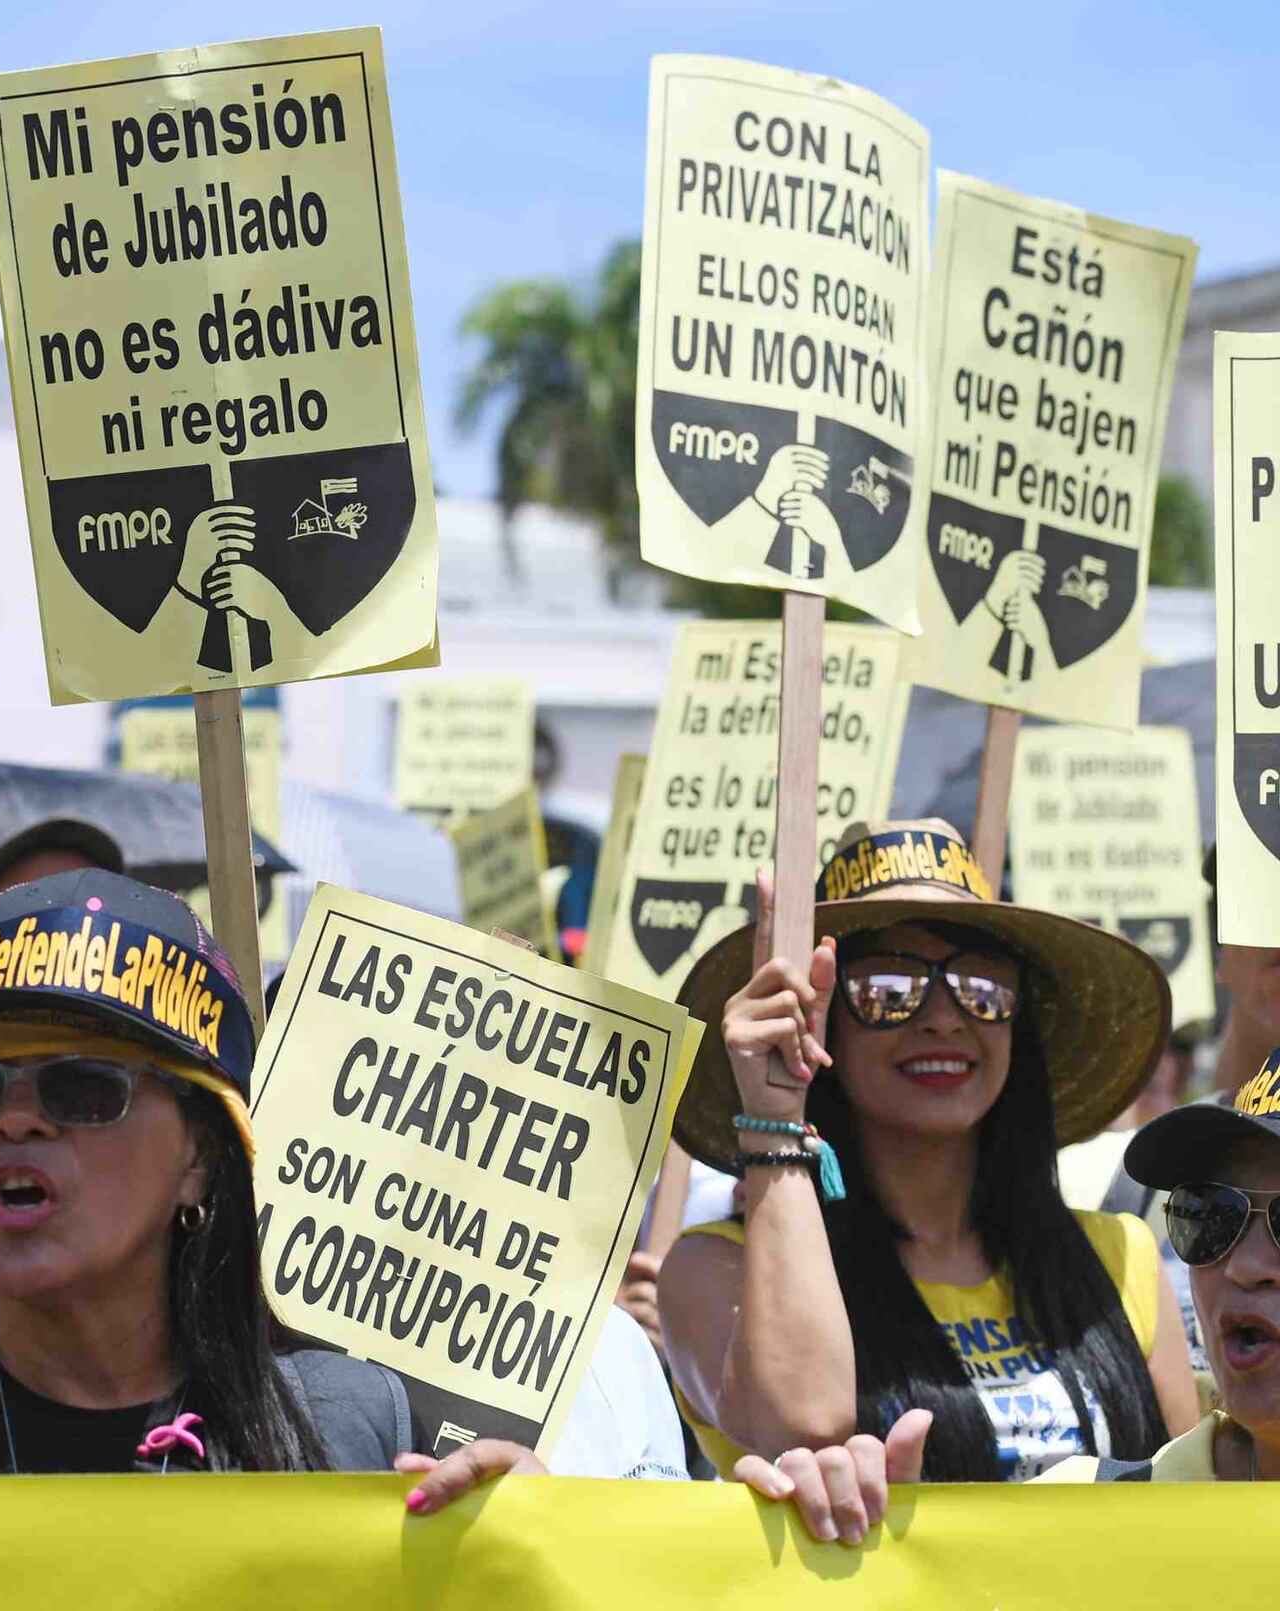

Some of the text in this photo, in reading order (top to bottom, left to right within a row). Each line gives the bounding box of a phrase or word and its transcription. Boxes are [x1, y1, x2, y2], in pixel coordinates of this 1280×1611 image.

[22, 78, 347, 186] Mi pensión
[734, 110, 883, 186] CON LA
[52, 174, 328, 278] de Jubilado
[677, 158, 911, 275] PRIVATIZACIÓN
[1010, 226, 1106, 299] Está
[40, 283, 383, 385] no es dádiva
[697, 253, 895, 346] ELLOS ROBAN
[982, 286, 1125, 384] Cañón
[101, 377, 329, 456] ni regalo
[671, 314, 907, 429] UN MONTÓN
[954, 366, 1138, 456] que bajen
[668, 421, 761, 467] FMPR
[943, 435, 1133, 533] mi Pensión
[78, 506, 174, 553] FMPR
[695, 640, 873, 688] mi Esela
[680, 695, 872, 755] la defido,
[665, 762, 858, 820] es lo úco
[660, 820, 837, 868] que teo
[317, 933, 651, 1105] LAS ESCUELAS
[332, 1036, 592, 1201] CHÁRTER
[277, 1137, 560, 1284] SON CUNA DE
[274, 1215, 573, 1393] CORRUPCIÓN
